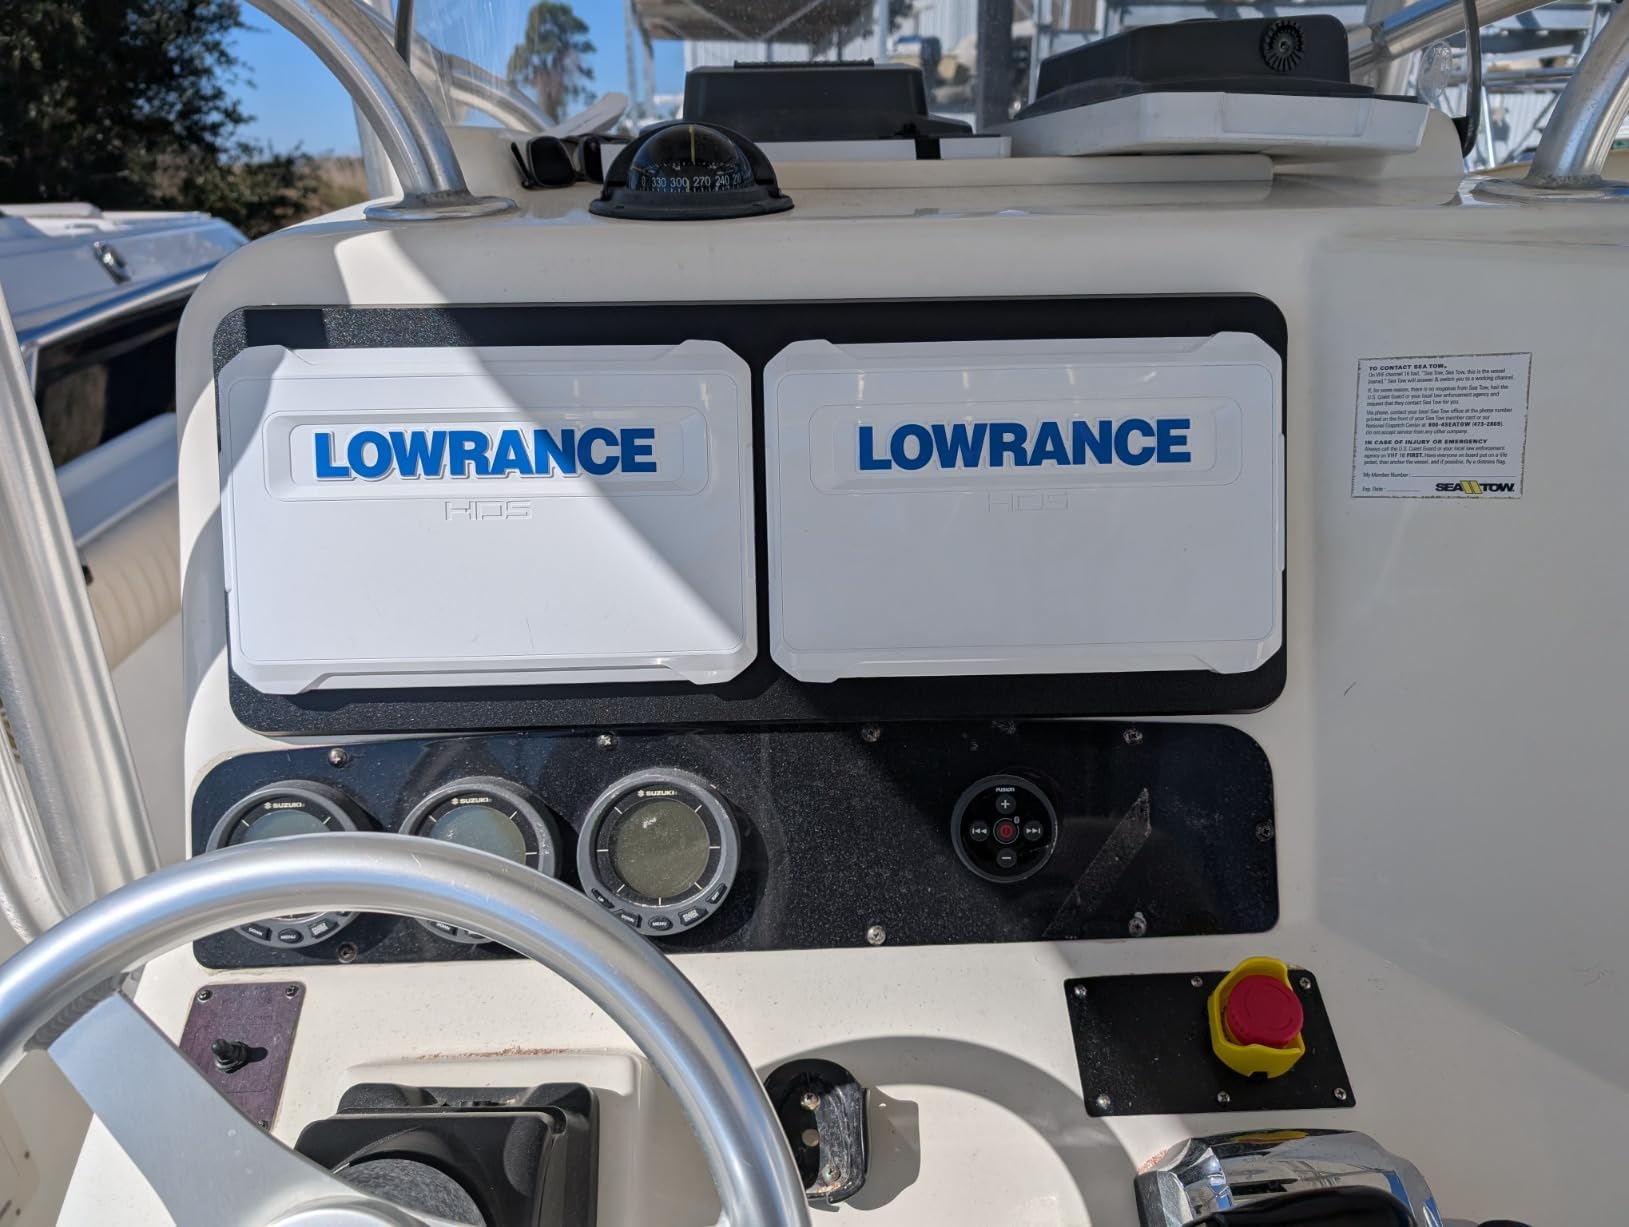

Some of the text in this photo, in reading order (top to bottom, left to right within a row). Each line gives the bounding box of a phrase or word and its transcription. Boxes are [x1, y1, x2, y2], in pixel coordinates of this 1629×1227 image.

[651, 177, 667, 188] 330
[670, 177, 688, 188] 300
[693, 176, 711, 187] 270
[715, 175, 730, 186] 240
[315, 428, 657, 479] LOWRANCE
[859, 418, 1191, 471] LOWRANCE
[1436, 483, 1463, 491] SEA
